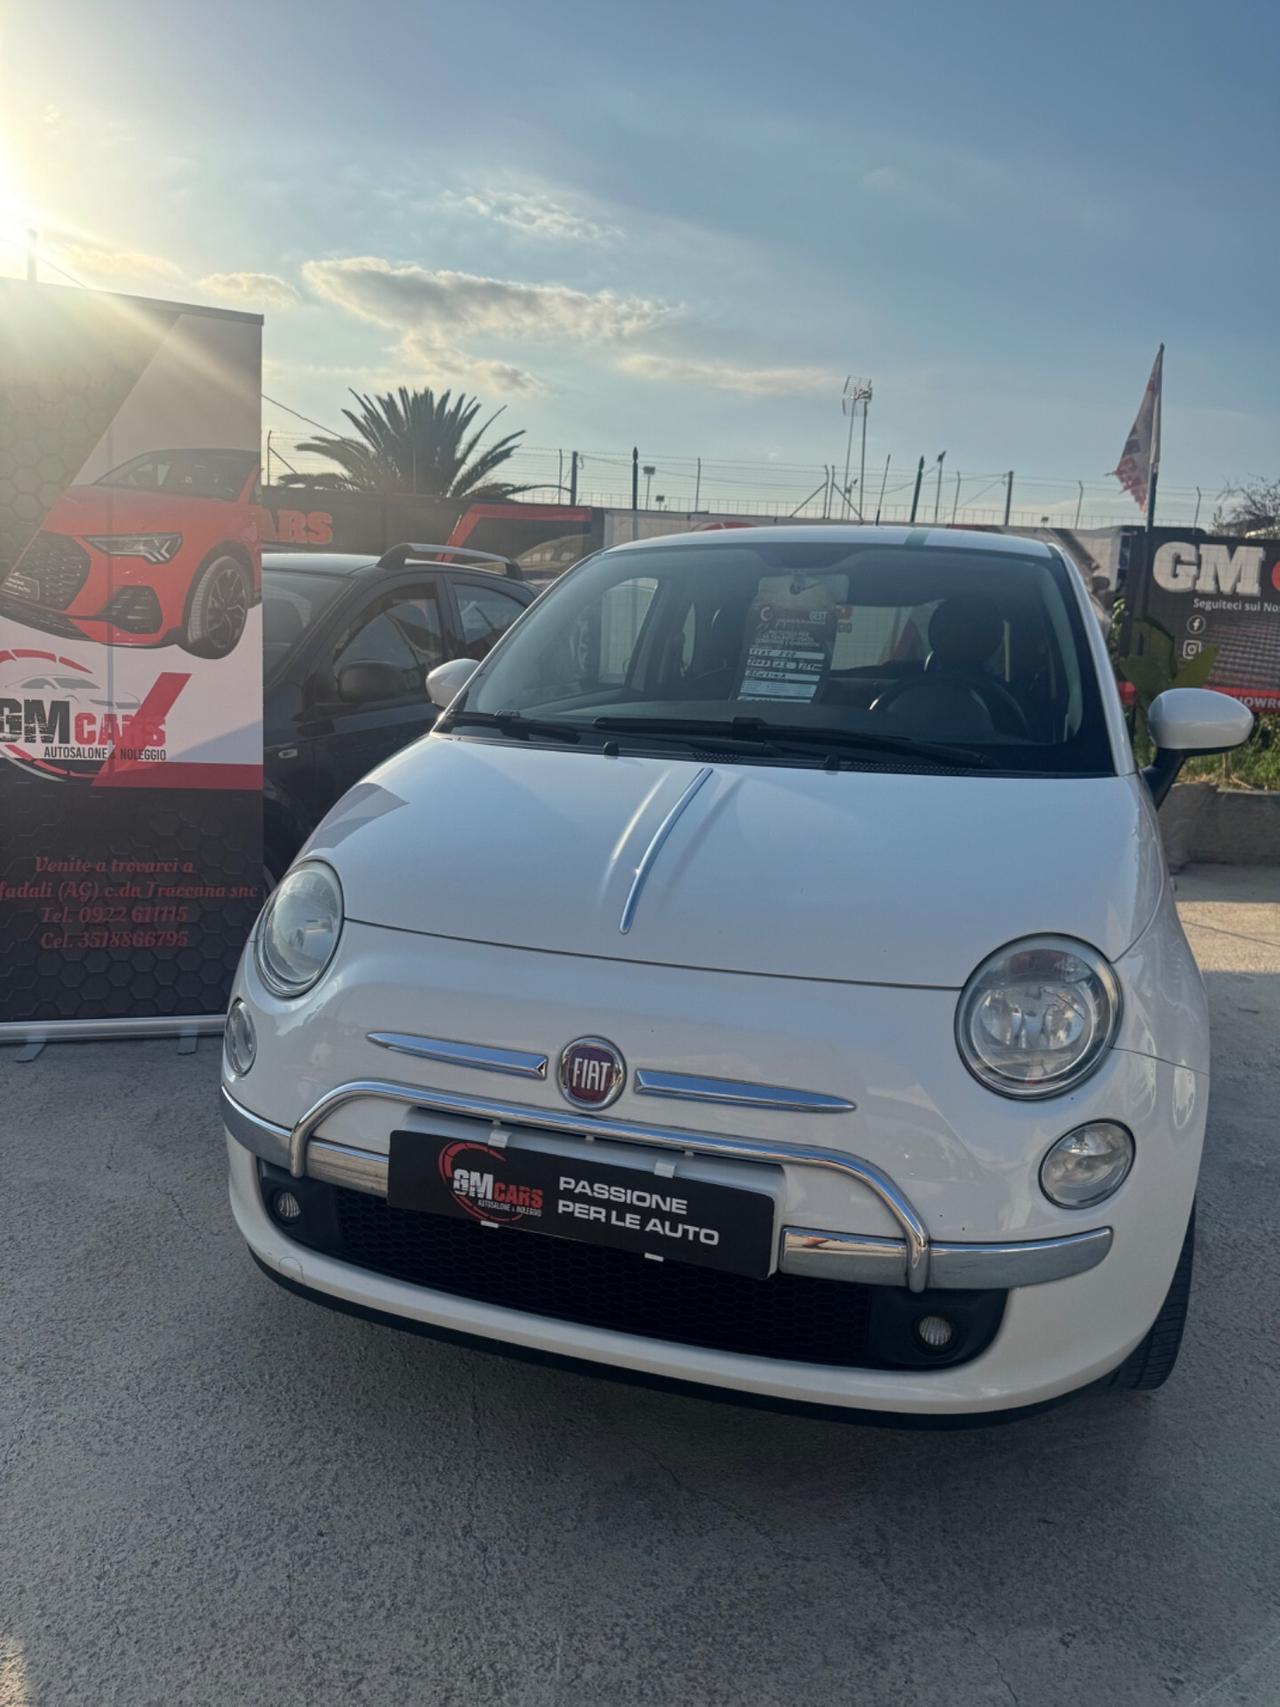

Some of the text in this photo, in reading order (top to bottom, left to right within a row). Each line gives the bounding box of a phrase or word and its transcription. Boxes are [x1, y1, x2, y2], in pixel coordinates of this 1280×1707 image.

[1152, 541, 1264, 597] GM
[1193, 598, 1241, 611] Seguiteci
[44, 746, 107, 760] AUTOSALONE
[120, 749, 167, 761] NOLEGGIO
[35, 856, 193, 874] Venite a trovarci a
[58, 881, 99, 903] (AG)
[105, 882, 141, 898] c.da
[229, 886, 257, 898] snc
[40, 906, 189, 924] Tel. 0922 611115
[40, 932, 72, 949] Cel.
[572, 1057, 611, 1091] FIAT
[453, 1168, 544, 1208] GM CARS
[559, 1176, 688, 1215] PASSIONE
[557, 1200, 719, 1246] PER LE AUTO
